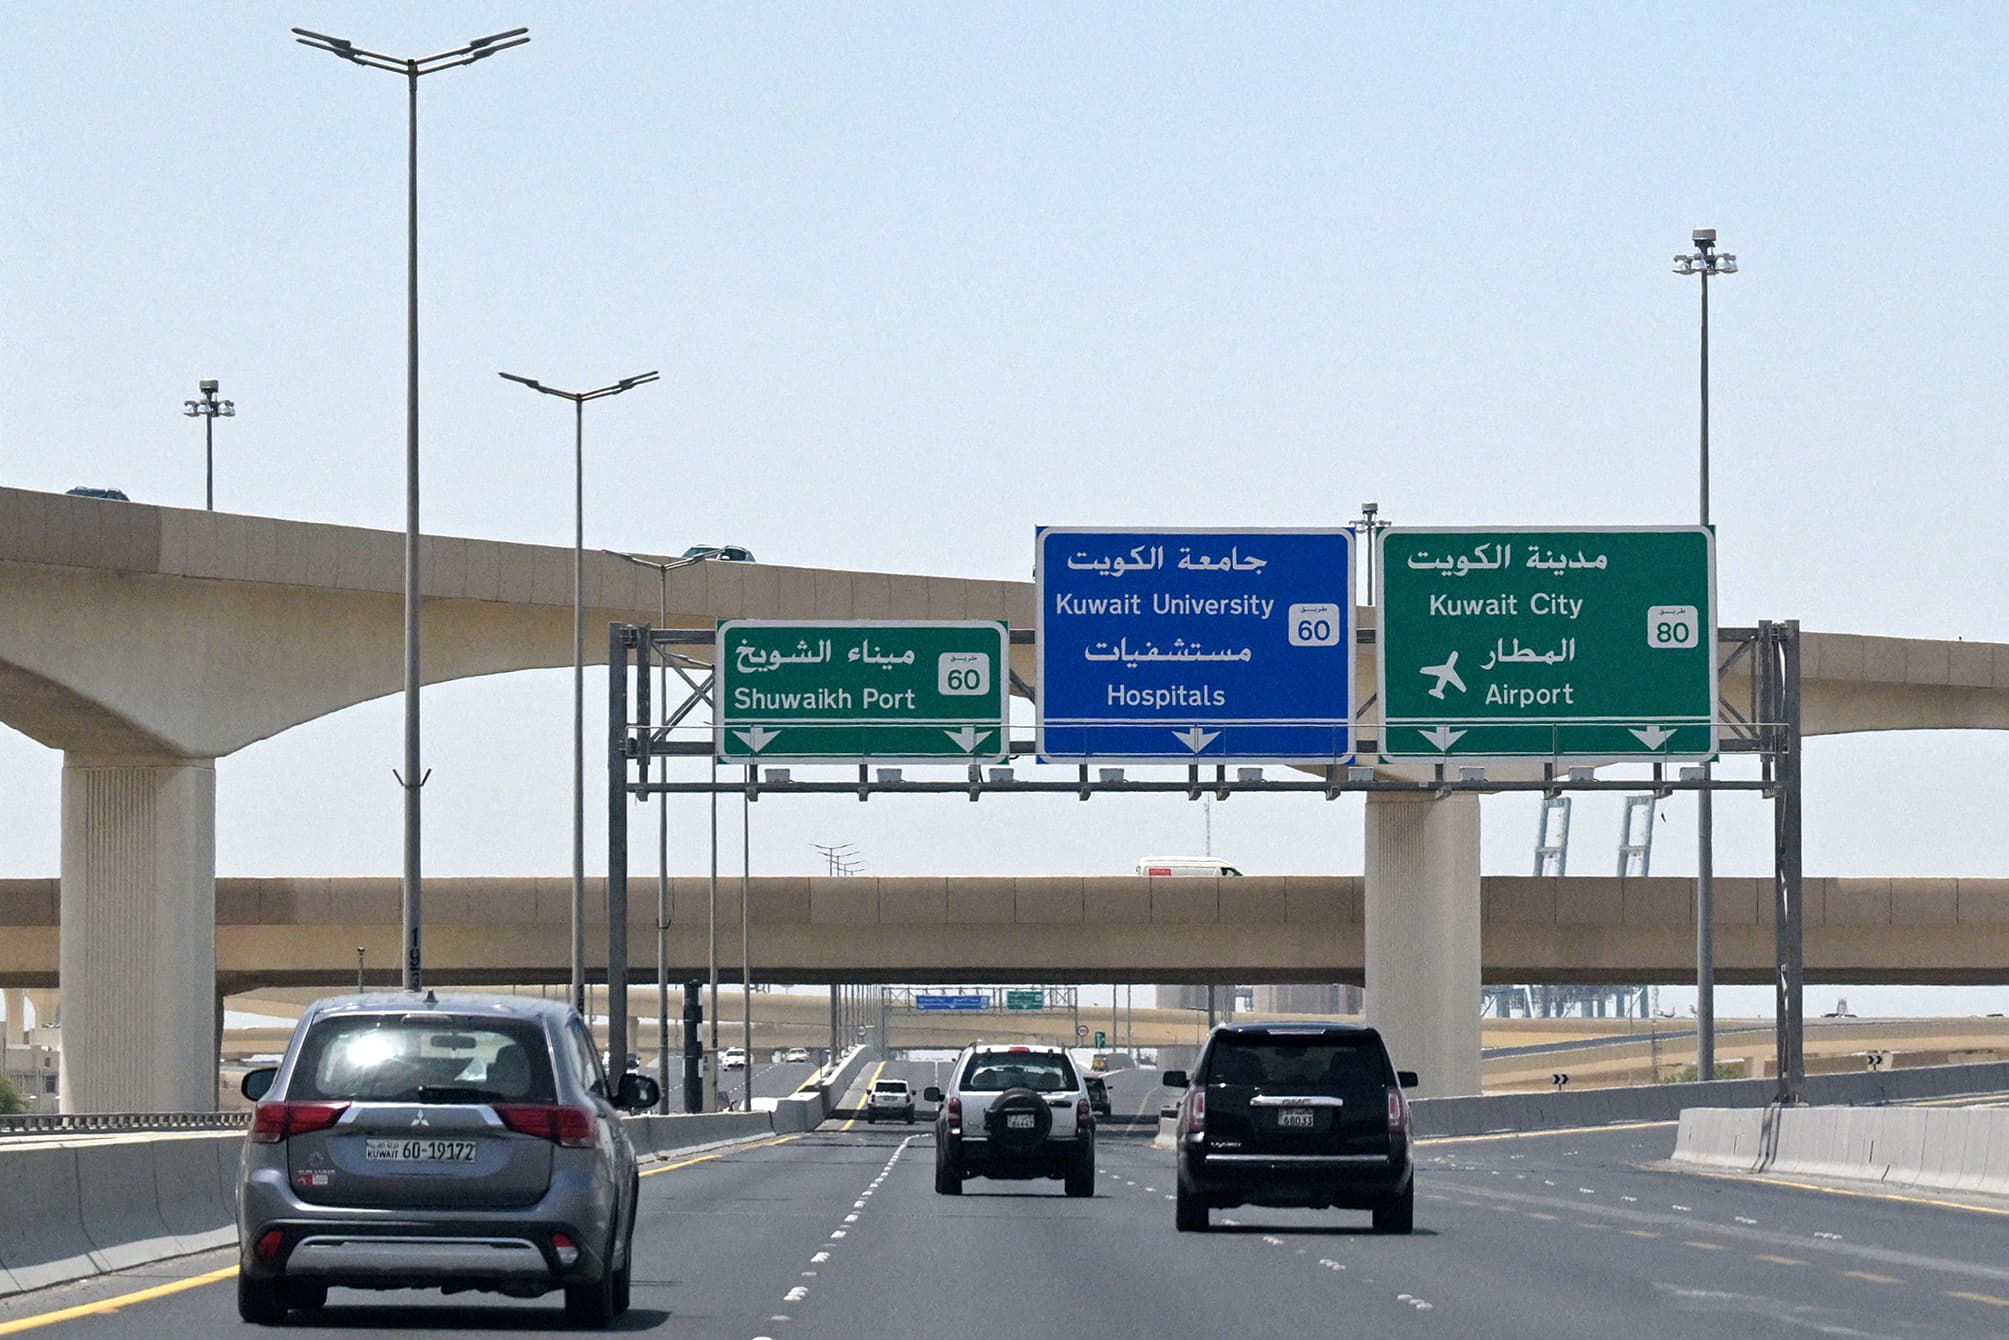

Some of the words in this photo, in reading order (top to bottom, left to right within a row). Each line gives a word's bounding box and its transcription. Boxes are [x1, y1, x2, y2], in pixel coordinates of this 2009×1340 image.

[1068, 546, 1163, 576] الكويت
[1178, 547, 1267, 574] جامعة
[1408, 543, 1510, 576] الكويت
[1527, 546, 1607, 575] مدينة
[1057, 594, 1140, 614] Kuwait
[1154, 594, 1274, 619] University
[1431, 594, 1517, 615] Kuwait
[1531, 593, 1582, 619] City
[1298, 620, 1330, 640] 60
[1657, 623, 1689, 643] 80
[736, 640, 831, 673] الشويخ
[848, 640, 914, 669] ميناء
[1085, 637, 1251, 668] مستشفيات
[1480, 638, 1575, 670] المطار
[948, 669, 980, 690] 60
[735, 688, 851, 709] Shuwaikh
[864, 688, 915, 709] Port
[1108, 685, 1225, 709] Hospitals
[1486, 684, 1573, 708] Airport
[367, 1150, 399, 1159] KUWAIT
